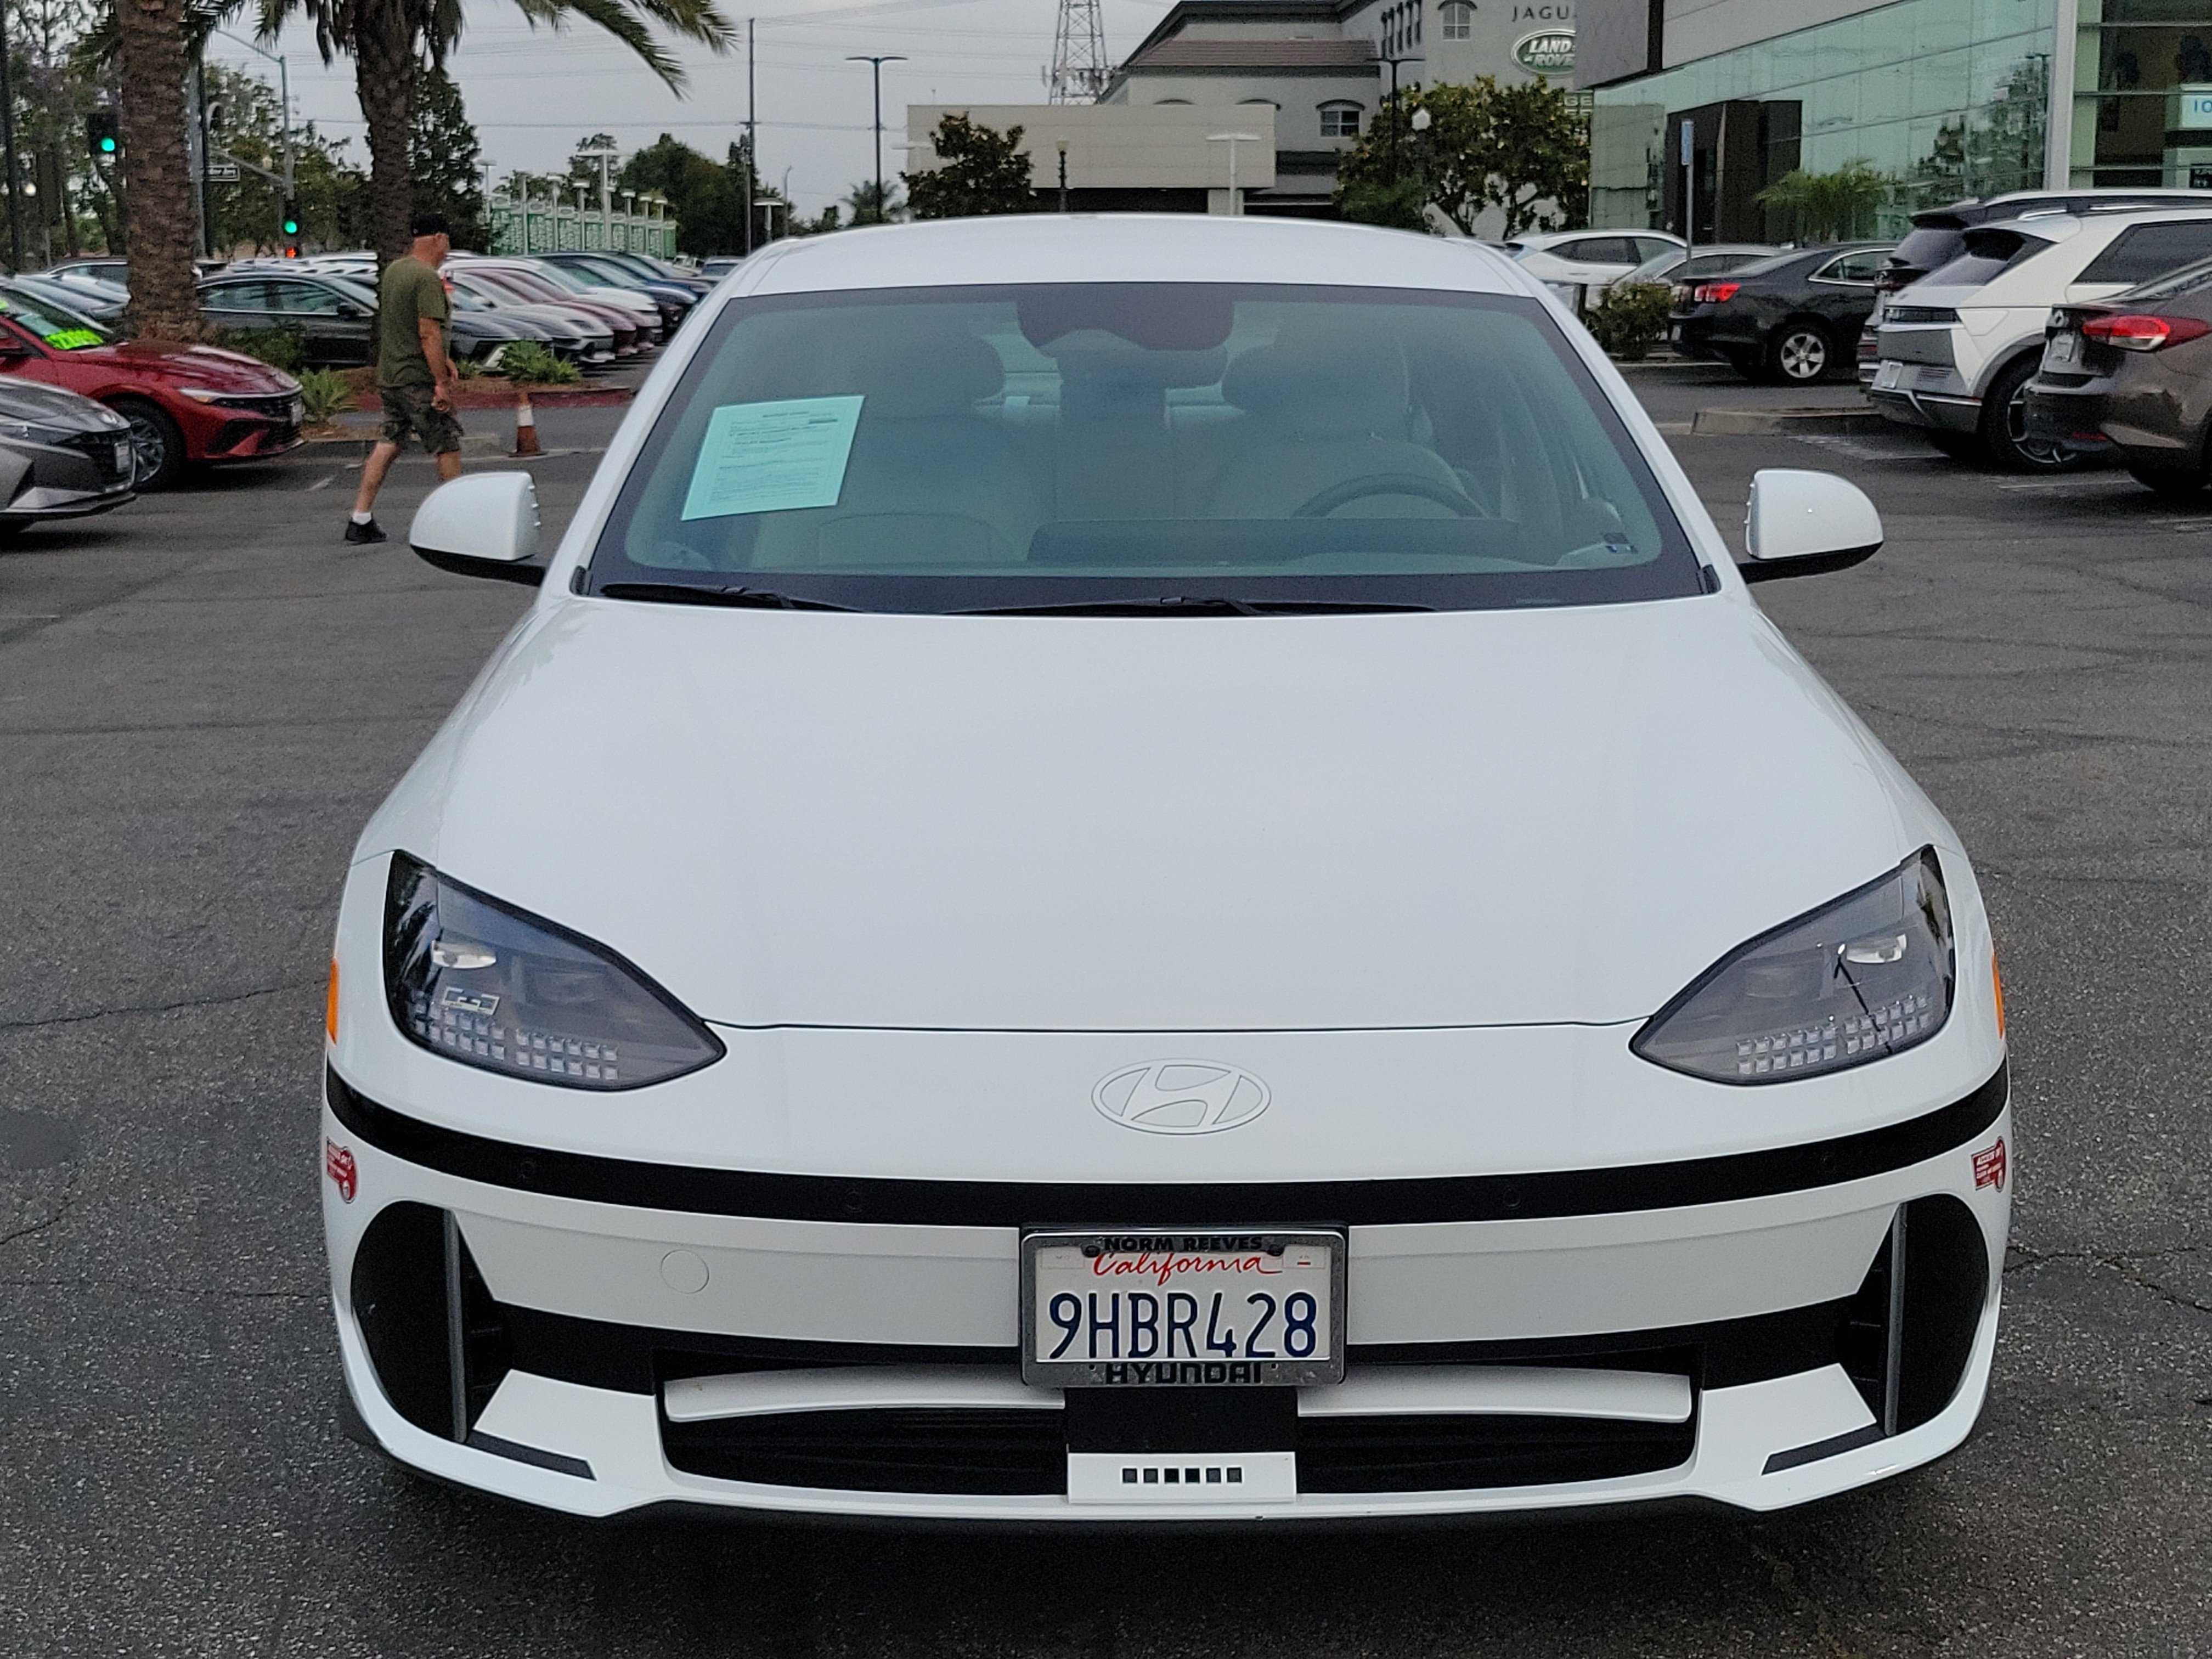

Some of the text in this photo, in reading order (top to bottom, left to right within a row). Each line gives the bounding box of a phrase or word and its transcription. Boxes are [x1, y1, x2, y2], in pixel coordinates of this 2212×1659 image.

[1530, 40, 1572, 53] LAND
[1104, 1237, 1262, 1251] NORM REEVES
[1093, 1252, 1283, 1286] California
[1049, 1293, 1317, 1359] 9HBR428
[1105, 1363, 1262, 1384] HYUNDAI
